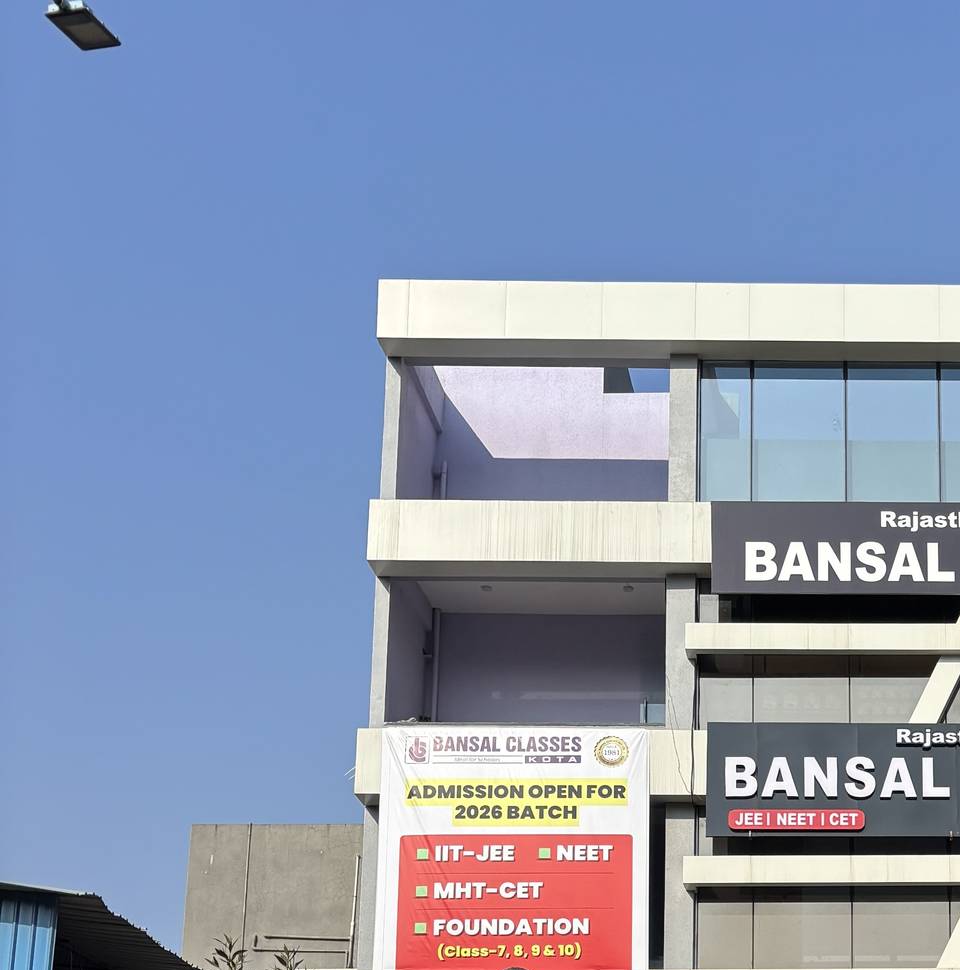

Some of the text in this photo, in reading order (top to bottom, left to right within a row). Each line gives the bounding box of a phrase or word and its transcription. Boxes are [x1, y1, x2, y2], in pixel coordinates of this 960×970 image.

[744, 541, 956, 583] BANSAL
[433, 736, 501, 752] BANSAL
[505, 736, 582, 752] CLASSES
[724, 756, 951, 798] BANSAL
[407, 784, 627, 799] ADMISSION OPEN FOR
[455, 805, 577, 819] 2026 BATCH
[735, 813, 763, 826] JEE
[776, 813, 817, 826] NEET
[829, 813, 859, 826] CET
[434, 845, 515, 862] IIT-JEE
[557, 845, 614, 861] NEET
[433, 881, 544, 899] MHT-CET
[433, 918, 590, 936] FOUNDATION
[437, 942, 581, 960] (Class-7, 8, 9 & 10)
